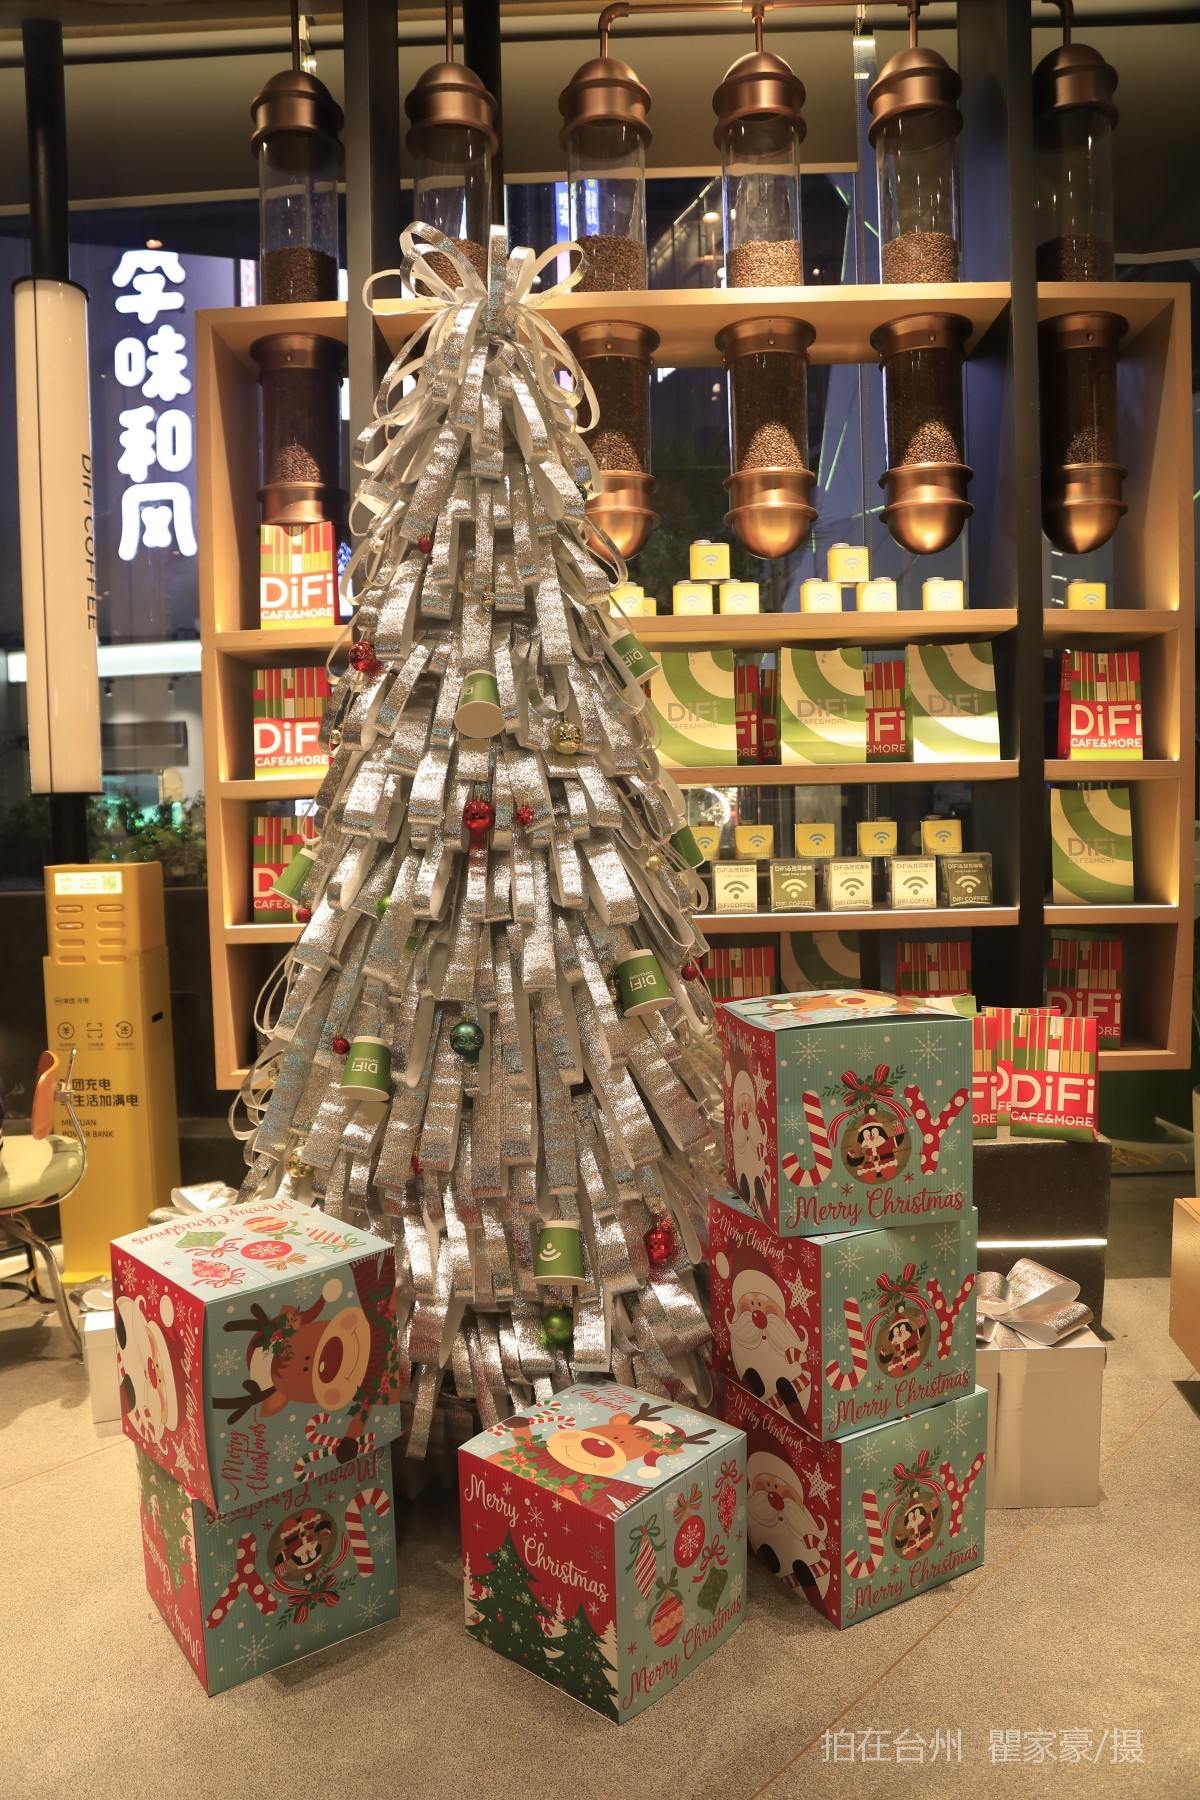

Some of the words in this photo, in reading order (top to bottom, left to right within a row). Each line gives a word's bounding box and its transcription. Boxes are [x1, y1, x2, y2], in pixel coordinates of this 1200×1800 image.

[261, 573, 334, 607] DiFi
[261, 607, 334, 620] CAFE&MORE
[624, 650, 644, 668] DiF
[667, 701, 718, 722] DiFi
[797, 698, 848, 718] DiFi
[1071, 703, 1142, 736] DiFi
[255, 721, 319, 755] DiF
[736, 714, 758, 744] Fi
[1071, 737, 1142, 748] CAFE&MORE
[255, 755, 329, 767] CAFE&MORE
[1067, 838, 1116, 857] DiFi
[629, 974, 657, 991] DiFi
[1047, 991, 1122, 1024] DiFi
[351, 1060, 378, 1074] DiFi
[58, 1078, 111, 1091] 团充电
[60, 1094, 138, 1107] 生活加满电
[1011, 1073, 1095, 1114] DiFi
[781, 1083, 971, 1187] JOY
[1011, 1110, 1094, 1127] CAFE&MORE
[229, 1200, 294, 1217] Merry
[785, 1196, 862, 1230] Merry
[866, 1187, 964, 1220] Christmas
[131, 1214, 232, 1246] Christmas
[712, 1215, 744, 1249] Merry
[743, 1227, 795, 1263] Christmas
[825, 1272, 976, 1392] JOY
[828, 1397, 892, 1433] Merry
[893, 1370, 970, 1409] Christmas
[726, 1390, 760, 1430] Merry
[760, 1413, 814, 1454] Christmas
[221, 1429, 249, 1501] Merry
[246, 1408, 270, 1497] Christmas
[464, 1473, 519, 1528] Merry
[844, 1450, 986, 1580] JOY
[522, 1535, 609, 1603] Christmas
[847, 1578, 905, 1620] Merry
[908, 1543, 978, 1588] Christmas
[622, 1654, 681, 1710] Merry
[682, 1596, 742, 1662] Christmas
